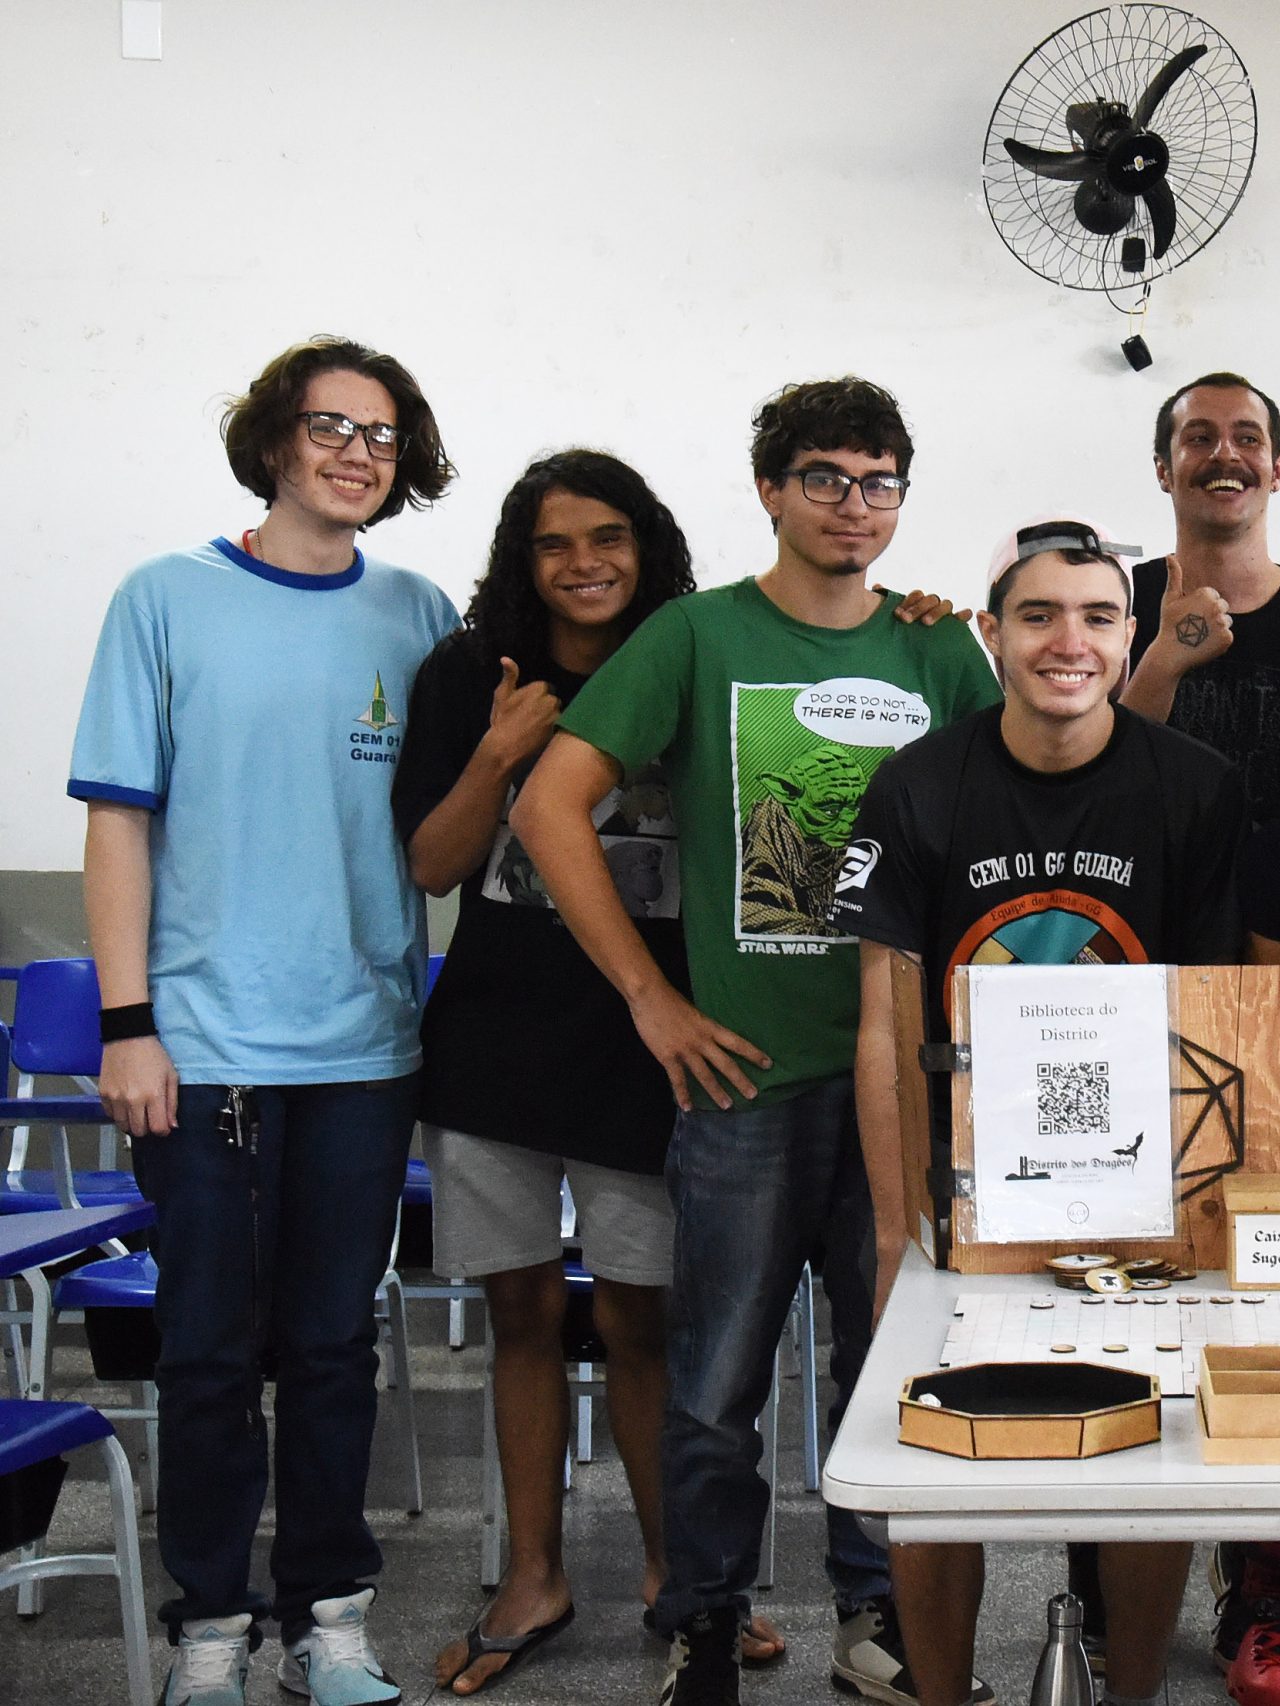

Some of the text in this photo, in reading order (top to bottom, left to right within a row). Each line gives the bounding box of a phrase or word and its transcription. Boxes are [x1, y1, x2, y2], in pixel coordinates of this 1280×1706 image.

[1122, 158, 1158, 171] VENSOL
[810, 693, 919, 712] DO OR DO NOT...
[802, 706, 928, 726] THERE IS NO TRY
[350, 732, 400, 747] CEM 01
[969, 856, 1010, 889] CEM
[1015, 852, 1035, 878] 01
[1074, 851, 1134, 887] GUARÁ
[834, 898, 863, 912] ENSINO
[990, 900, 1025, 921] Equipe
[736, 941, 829, 955] STAR WARS
[1019, 1002, 1118, 1018] Biblioteca do
[1040, 1027, 1098, 1041] Distrito
[1028, 1159, 1068, 1170] Distrito
[1070, 1159, 1088, 1169] dos
